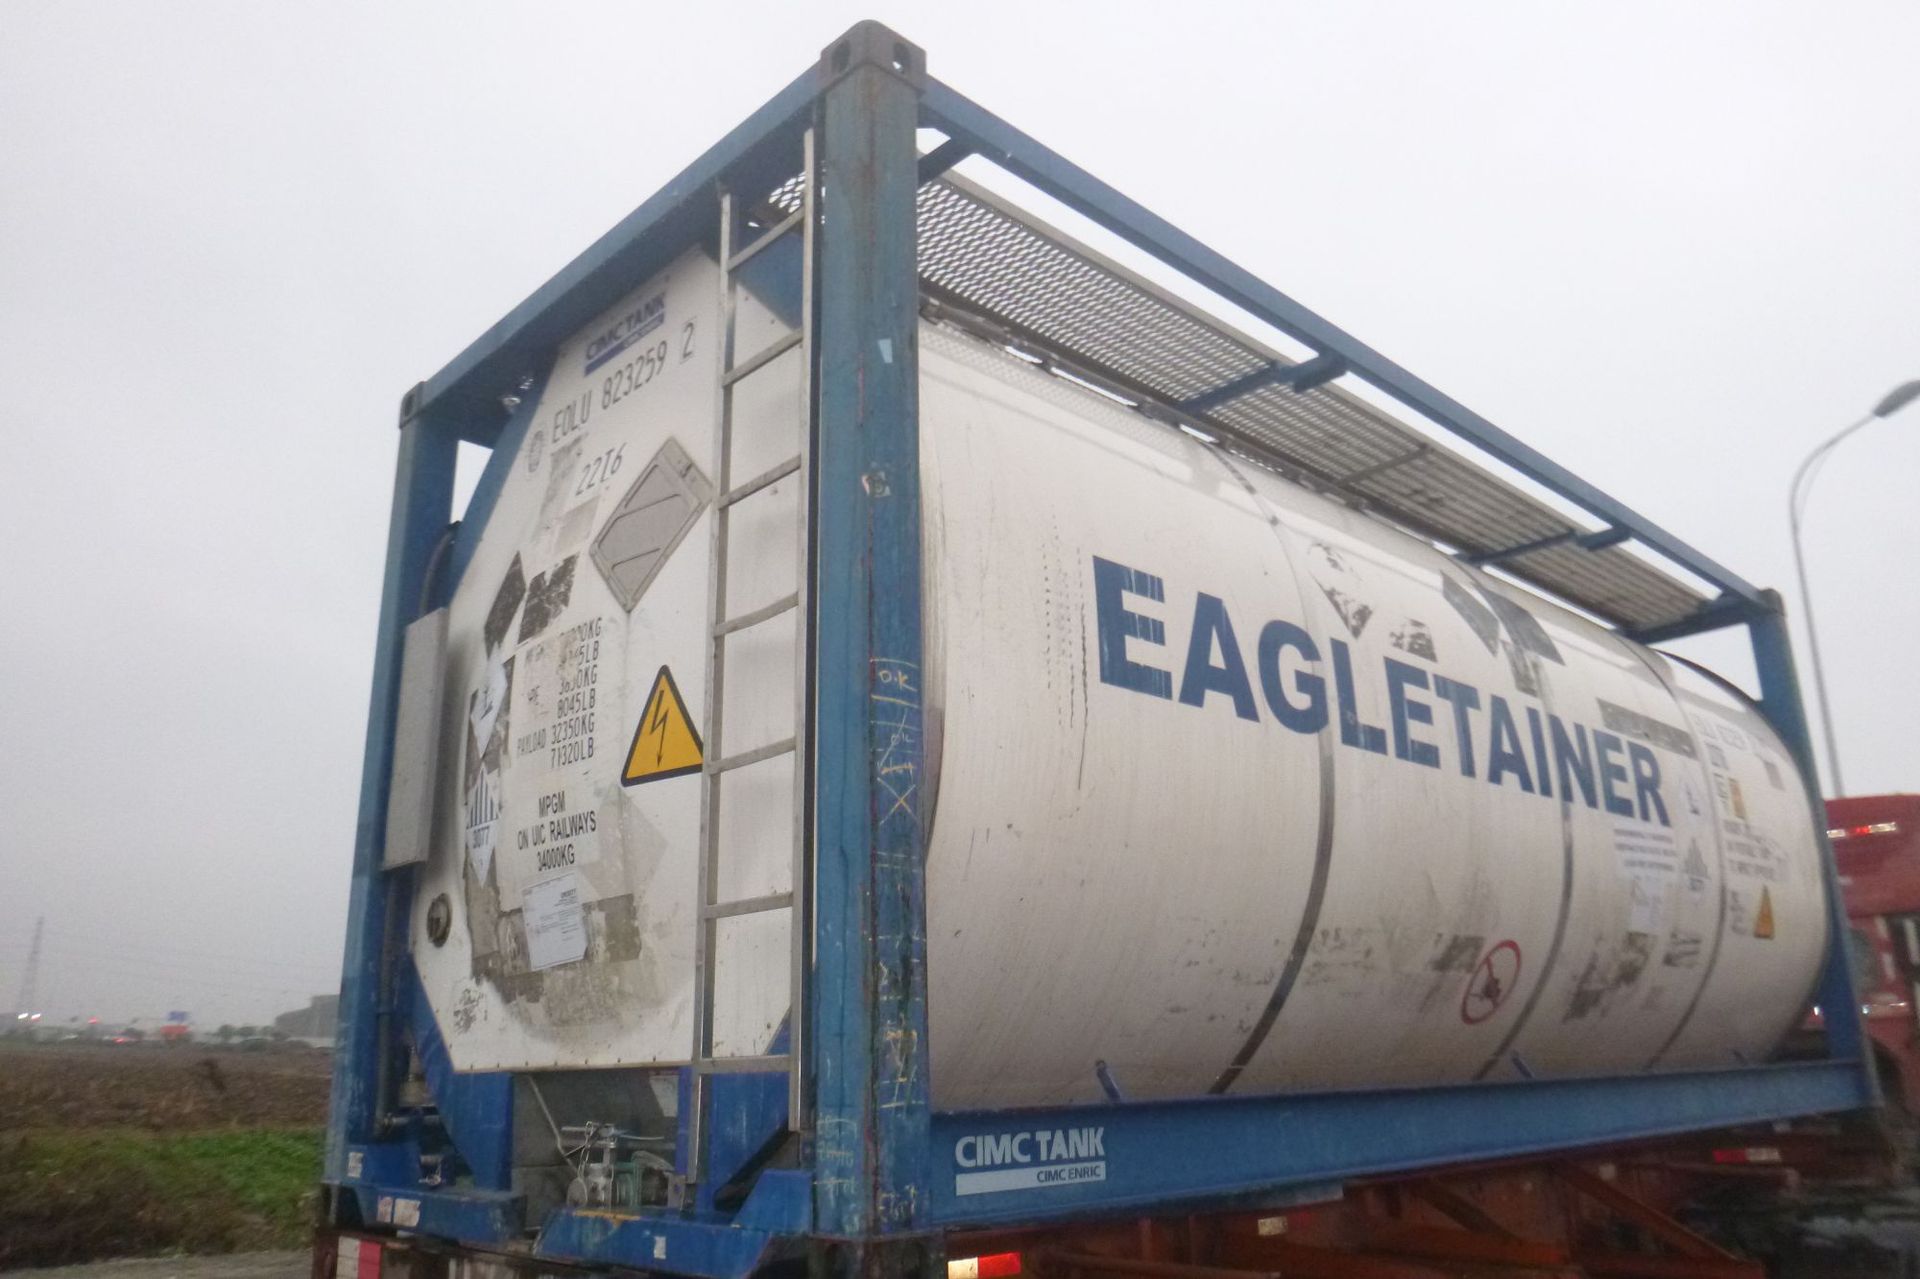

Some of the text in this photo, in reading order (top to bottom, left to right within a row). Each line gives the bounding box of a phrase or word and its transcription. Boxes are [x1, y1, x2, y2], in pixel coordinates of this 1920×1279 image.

[601, 340, 668, 410] 823259
[682, 322, 694, 360] 2
[1093, 555, 1671, 827] EAGLETAINER
[551, 712, 595, 745] 32350KG
[551, 737, 594, 769] 71320LB
[538, 791, 566, 818] MPGM
[517, 810, 597, 850] ON UIC RAILWAYS
[538, 843, 575, 872] 34000KG
[955, 1127, 1105, 1168] CIMC TANK
[1037, 1165, 1101, 1183] CIMC ENRIC
